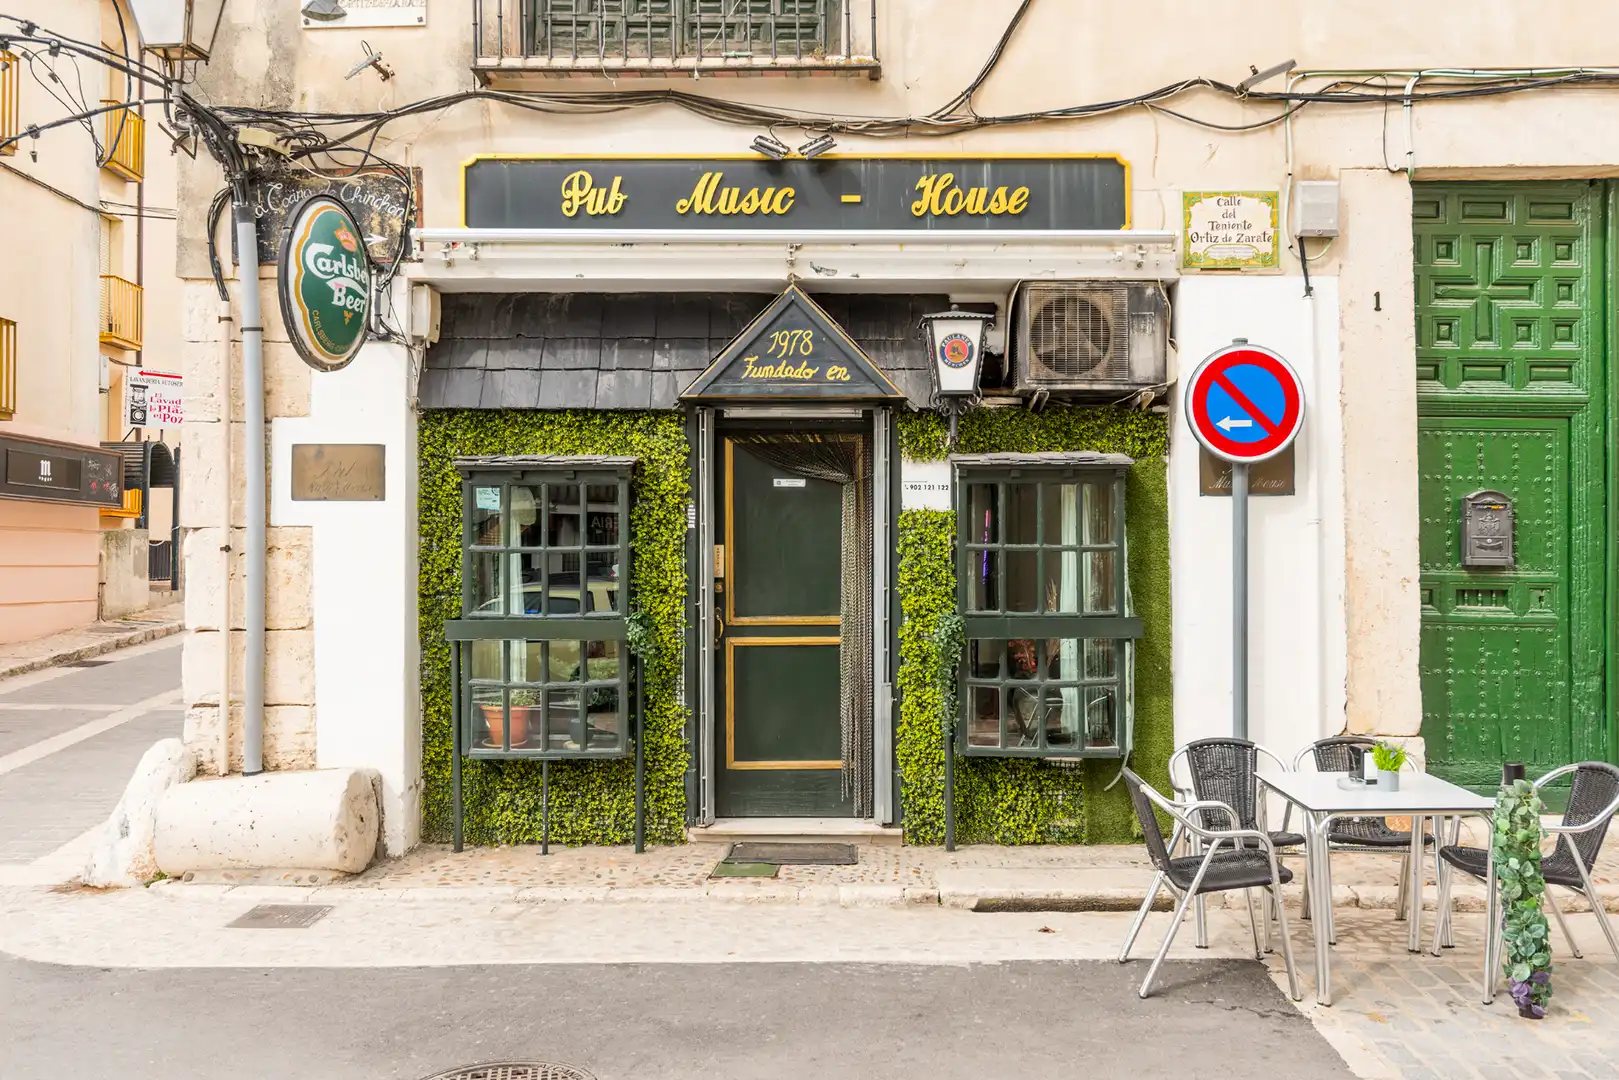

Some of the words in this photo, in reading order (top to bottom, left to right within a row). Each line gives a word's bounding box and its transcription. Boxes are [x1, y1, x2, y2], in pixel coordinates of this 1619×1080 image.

[561, 170, 628, 217] Pub
[675, 172, 796, 215] Music
[911, 172, 1030, 217] House
[1216, 196, 1242, 207] Calle
[1222, 208, 1236, 219] del
[1208, 220, 1253, 231] Teniente
[1190, 231, 1219, 243] Ortiz
[1222, 233, 1233, 243] de
[1236, 231, 1273, 243] Zarate
[331, 283, 366, 313] Beer
[1373, 291, 1382, 312] 1
[767, 329, 814, 358] 1978
[742, 355, 819, 379] Fundado
[826, 365, 851, 381] en
